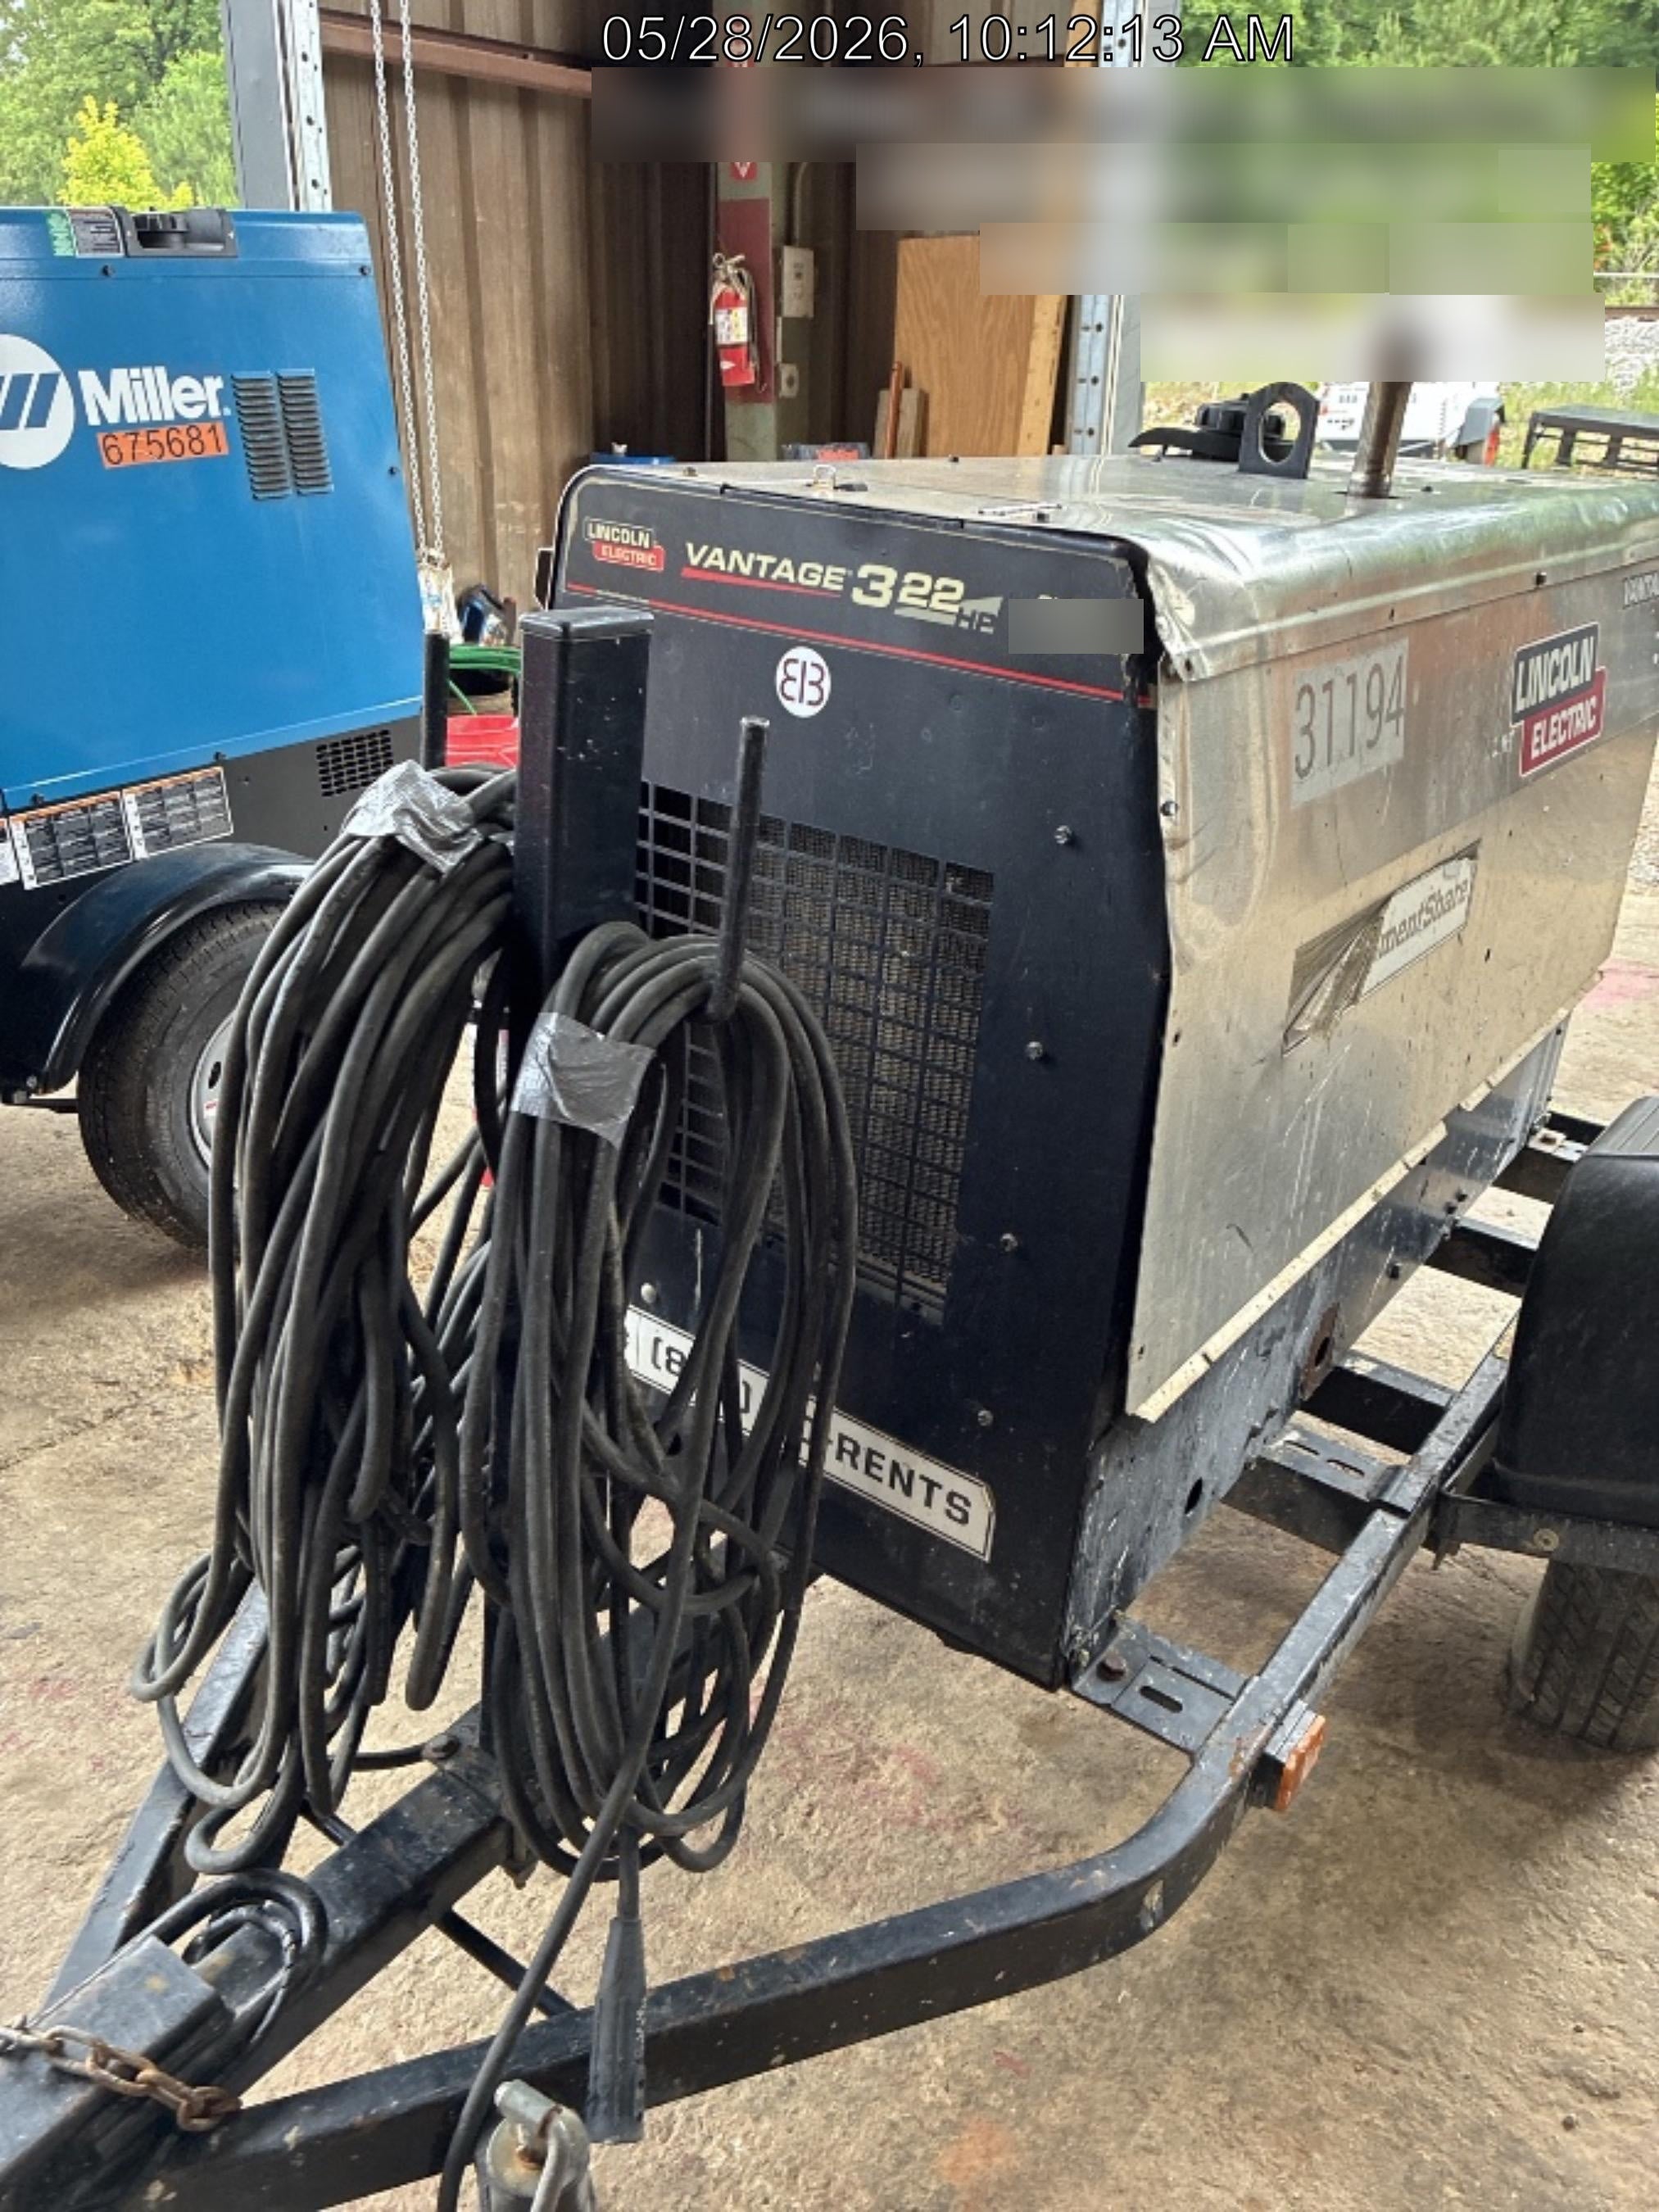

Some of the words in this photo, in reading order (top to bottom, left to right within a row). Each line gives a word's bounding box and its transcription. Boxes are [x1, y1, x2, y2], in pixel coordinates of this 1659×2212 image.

[101, 423, 223, 466] 675681
[587, 521, 650, 550] LINCOLN
[601, 544, 657, 566] ELECTRIC
[684, 542, 848, 592] VANTAGE
[850, 563, 965, 615] 322
[1515, 635, 1595, 714] LINCOLN
[1294, 653, 1405, 780] 31194
[1530, 696, 1598, 761] ELECTRIC
